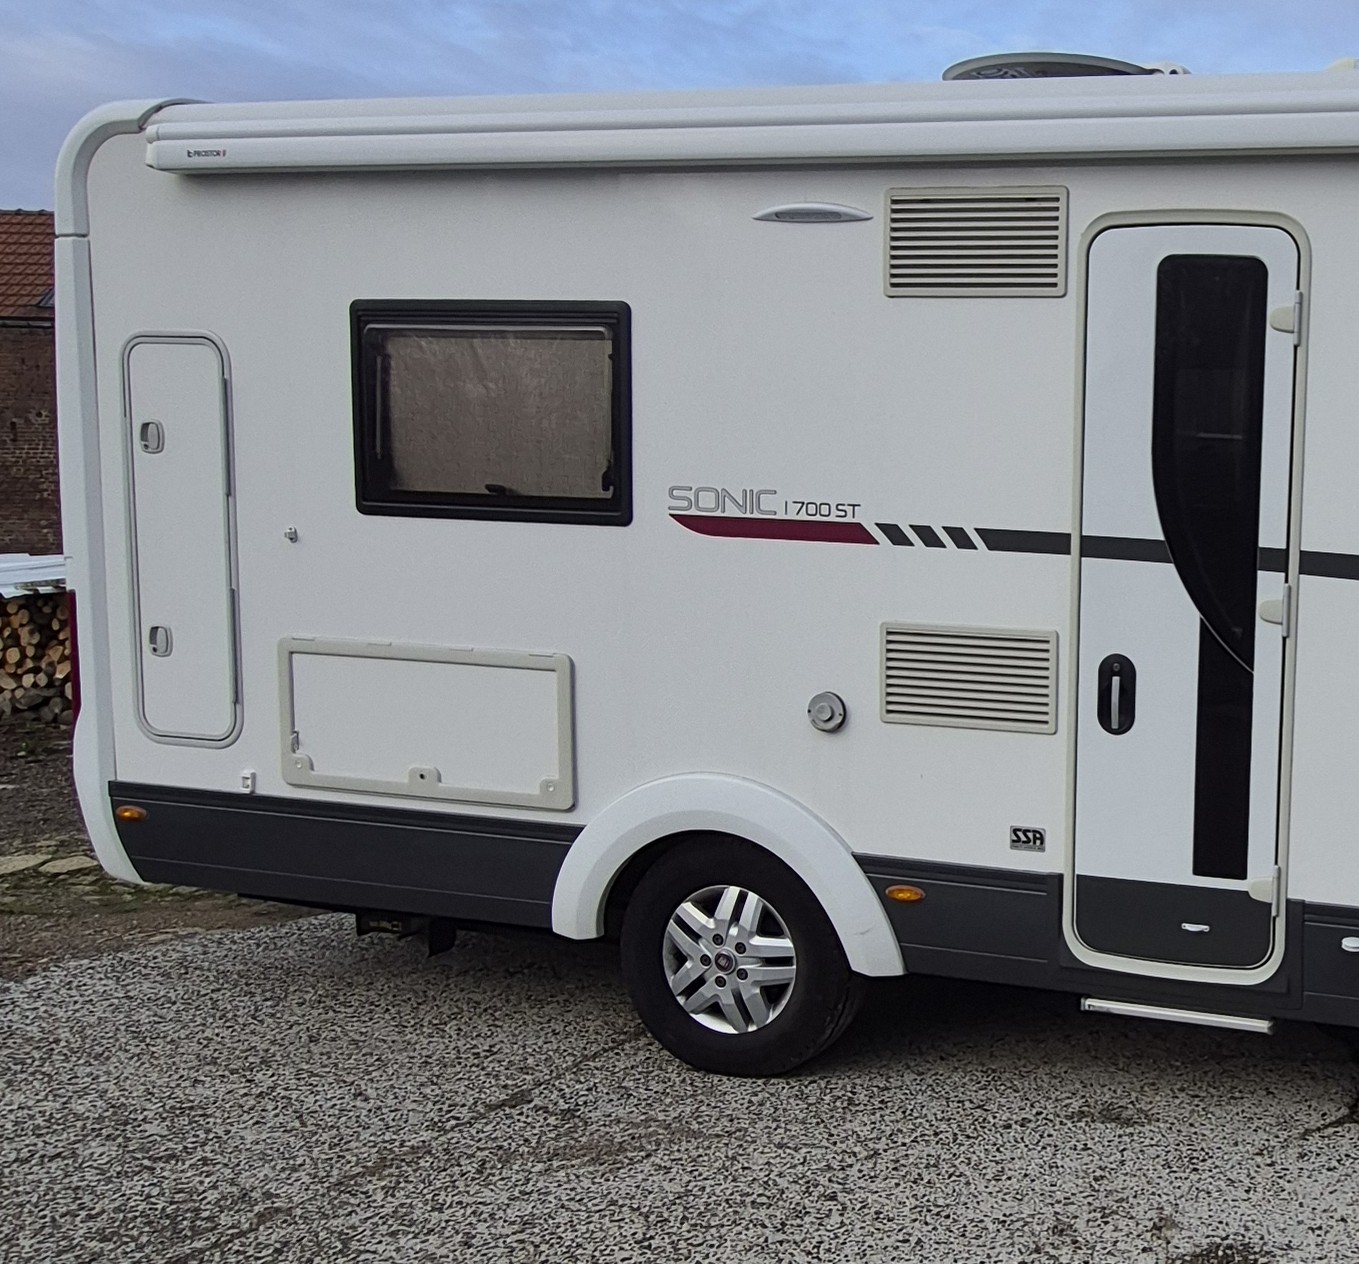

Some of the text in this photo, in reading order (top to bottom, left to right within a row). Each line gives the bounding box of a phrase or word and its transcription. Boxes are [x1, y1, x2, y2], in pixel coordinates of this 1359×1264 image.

[668, 486, 777, 515] SONIC
[792, 501, 831, 517] 700
[835, 503, 862, 519] ST
[1011, 828, 1044, 845] SSA
